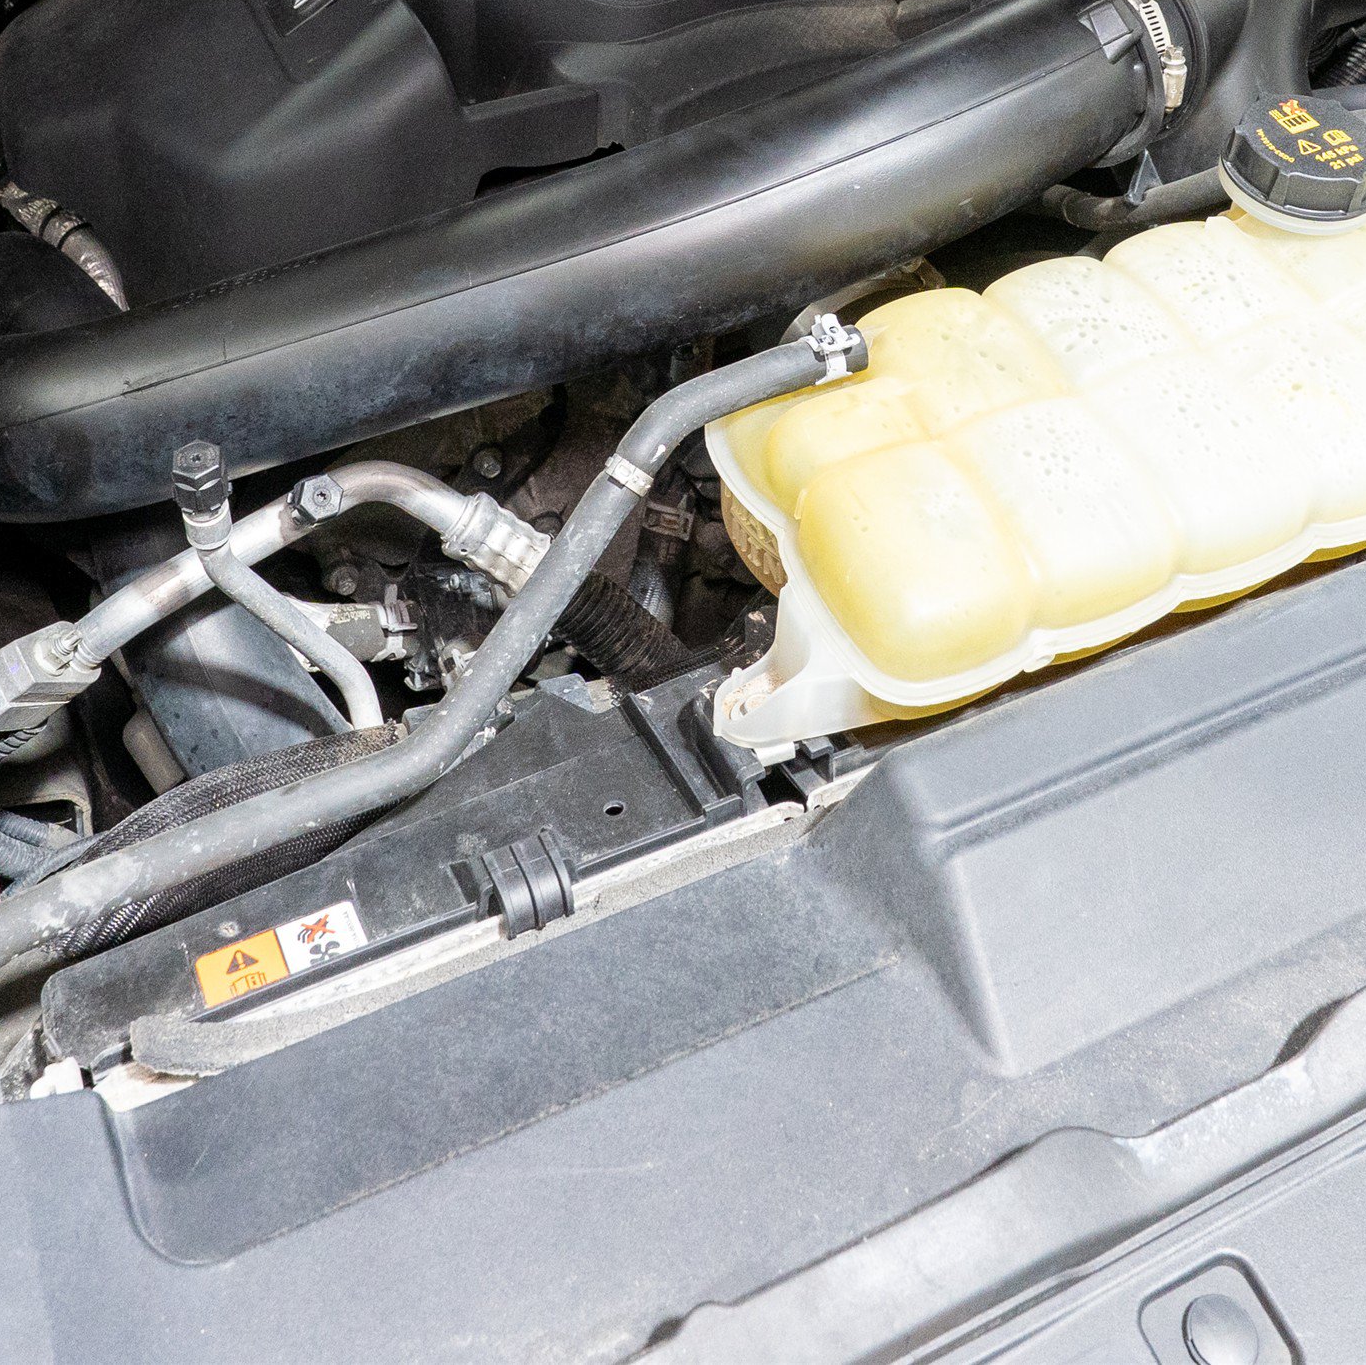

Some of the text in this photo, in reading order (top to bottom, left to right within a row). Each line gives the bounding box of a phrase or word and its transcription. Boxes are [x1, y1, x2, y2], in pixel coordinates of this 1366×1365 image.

[1315, 144, 1358, 162] 145 kPa
[1330, 155, 1364, 170] 21 psi
